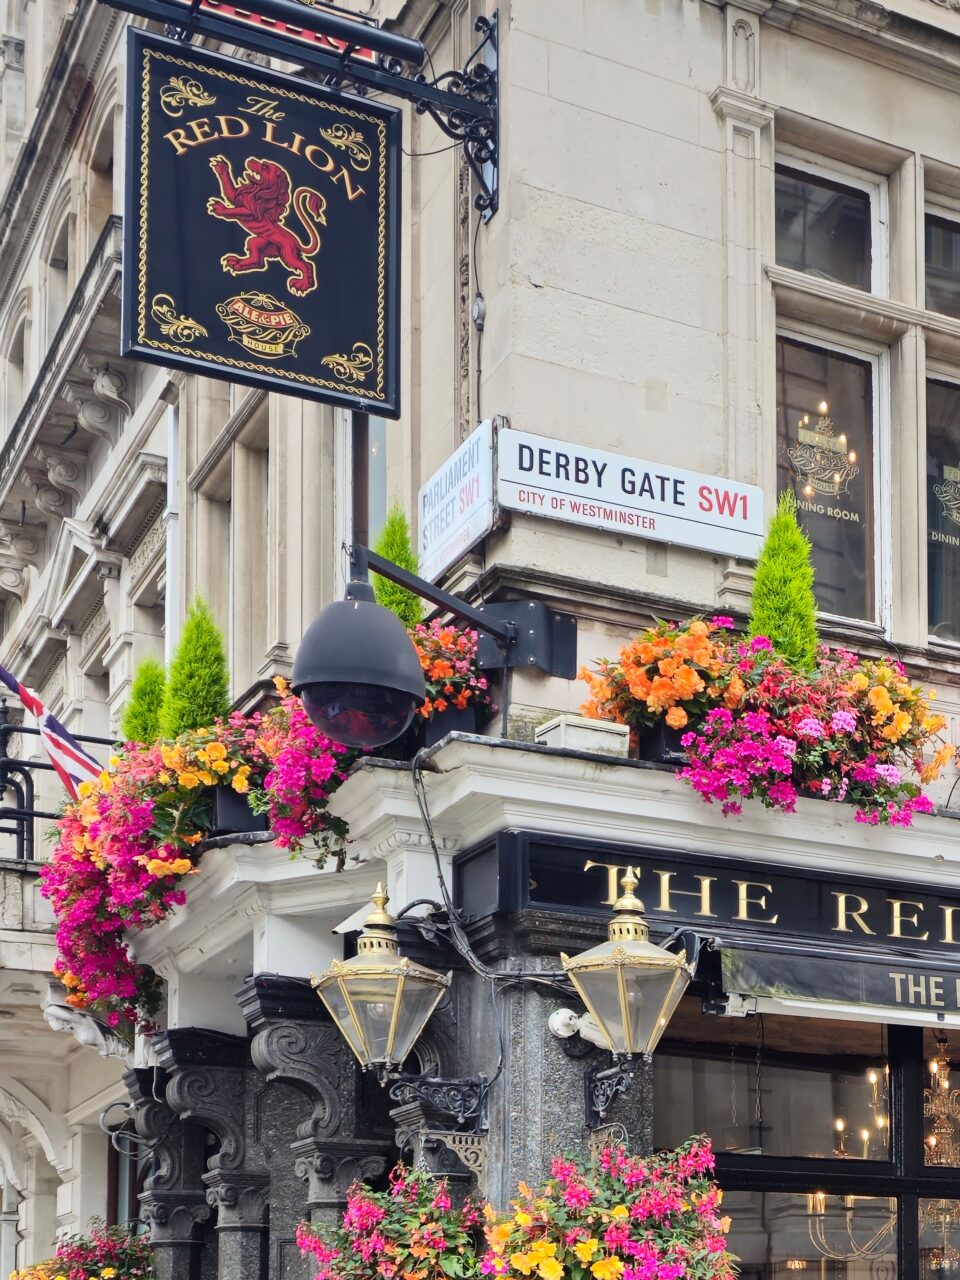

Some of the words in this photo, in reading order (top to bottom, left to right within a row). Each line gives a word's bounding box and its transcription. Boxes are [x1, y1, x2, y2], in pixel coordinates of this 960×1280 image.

[237, 96, 286, 122] The
[163, 115, 250, 156] RED
[261, 123, 367, 201] LION
[247, 340, 280, 352] HOUSE
[422, 437, 481, 519] PARLIAMENT
[518, 443, 608, 488] DERBY
[620, 468, 686, 506] GATE
[698, 485, 749, 520] SW1
[422, 494, 456, 551] STREET
[458, 474, 480, 515] SW1
[518, 489, 545, 506] CITY
[551, 498, 566, 510] OF
[569, 503, 656, 531] WESTMINSTER
[827, 507, 860, 522] ROOM
[584, 859, 778, 924] THE
[889, 972, 946, 1007] THE
